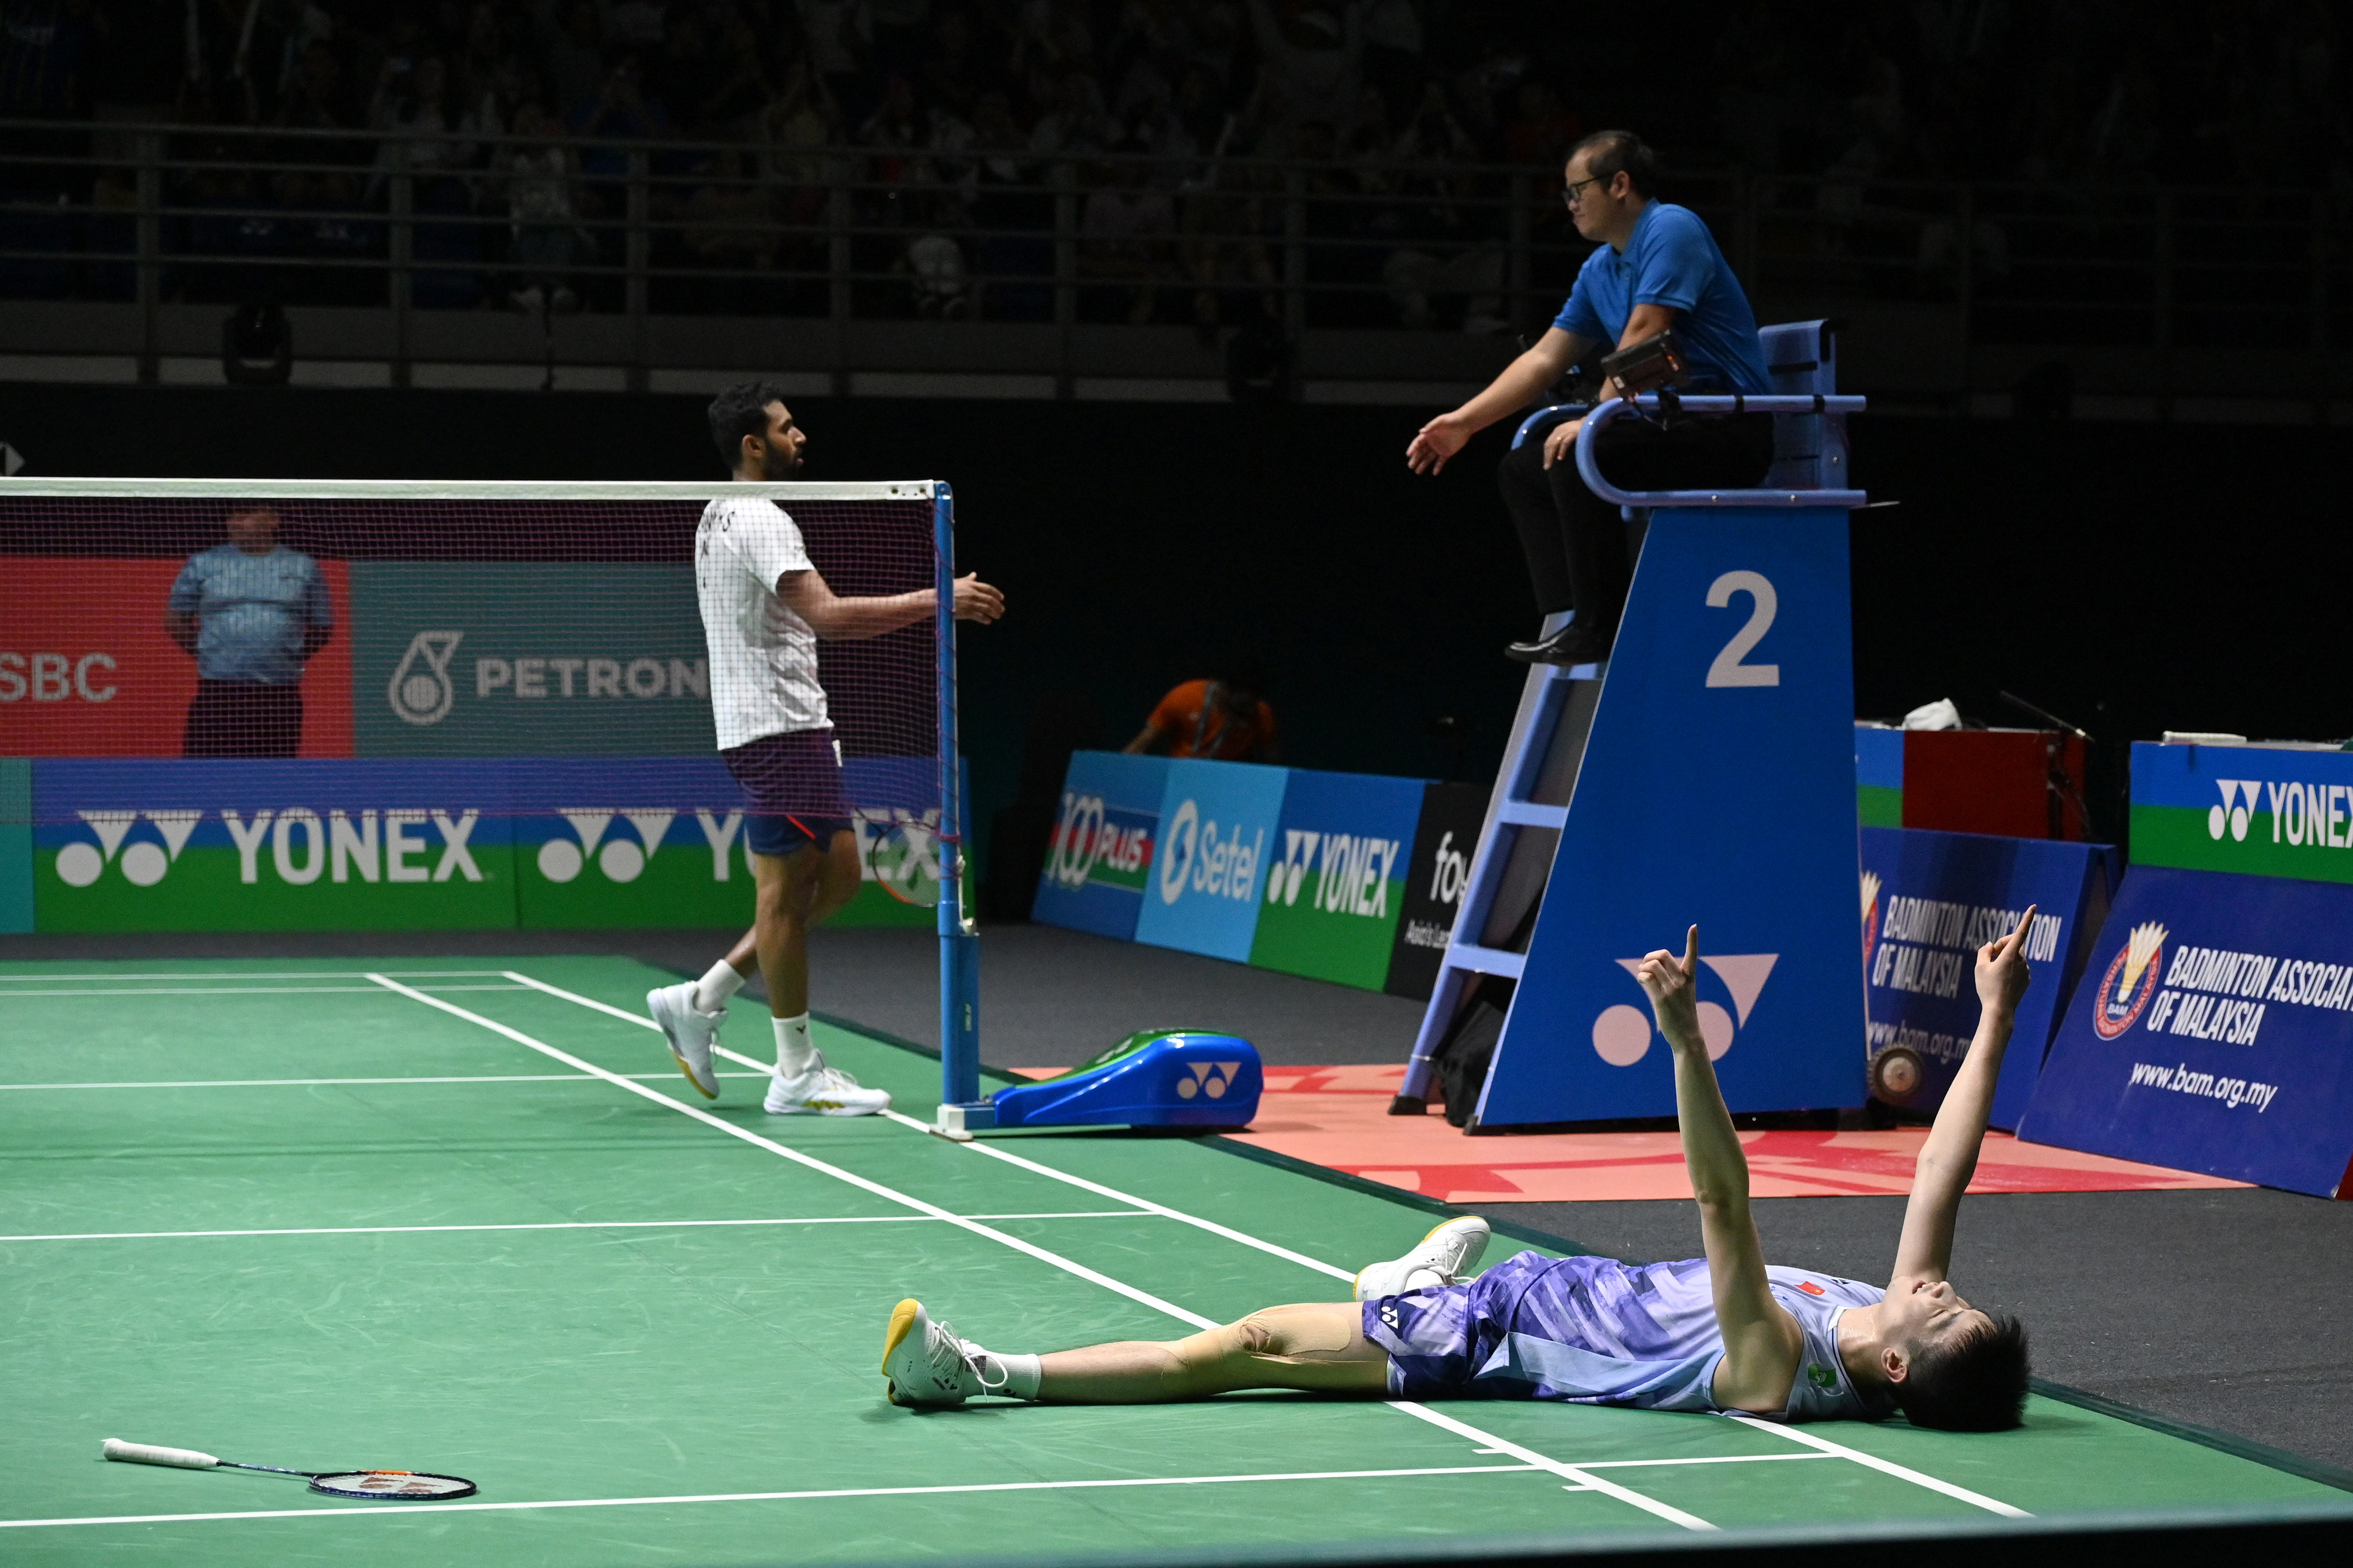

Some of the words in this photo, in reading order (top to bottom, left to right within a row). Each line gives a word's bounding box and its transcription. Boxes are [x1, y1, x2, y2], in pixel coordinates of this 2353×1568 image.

[1705, 570, 1780, 687] 2
[0, 652, 117, 702] SBC
[477, 658, 708, 698] PETRON
[221, 807, 483, 884] YONEX
[696, 807, 941, 882] YEX
[1195, 820, 1264, 902] Setel
[1314, 832, 1400, 919] YONEX
[1882, 894, 1968, 948] BADMINTON
[1963, 906, 2062, 962] ASSOCITION
[1872, 942, 1897, 987] OF
[1890, 946, 1963, 1000] MALAYSIA
[2164, 945, 2278, 999] BADMINTON
[2107, 1002, 2129, 1016] BAM
[2147, 989, 2181, 1032] OF
[2170, 993, 2266, 1046] MALAYSIA
[2131, 1063, 2278, 1113] www.bam.org.my
